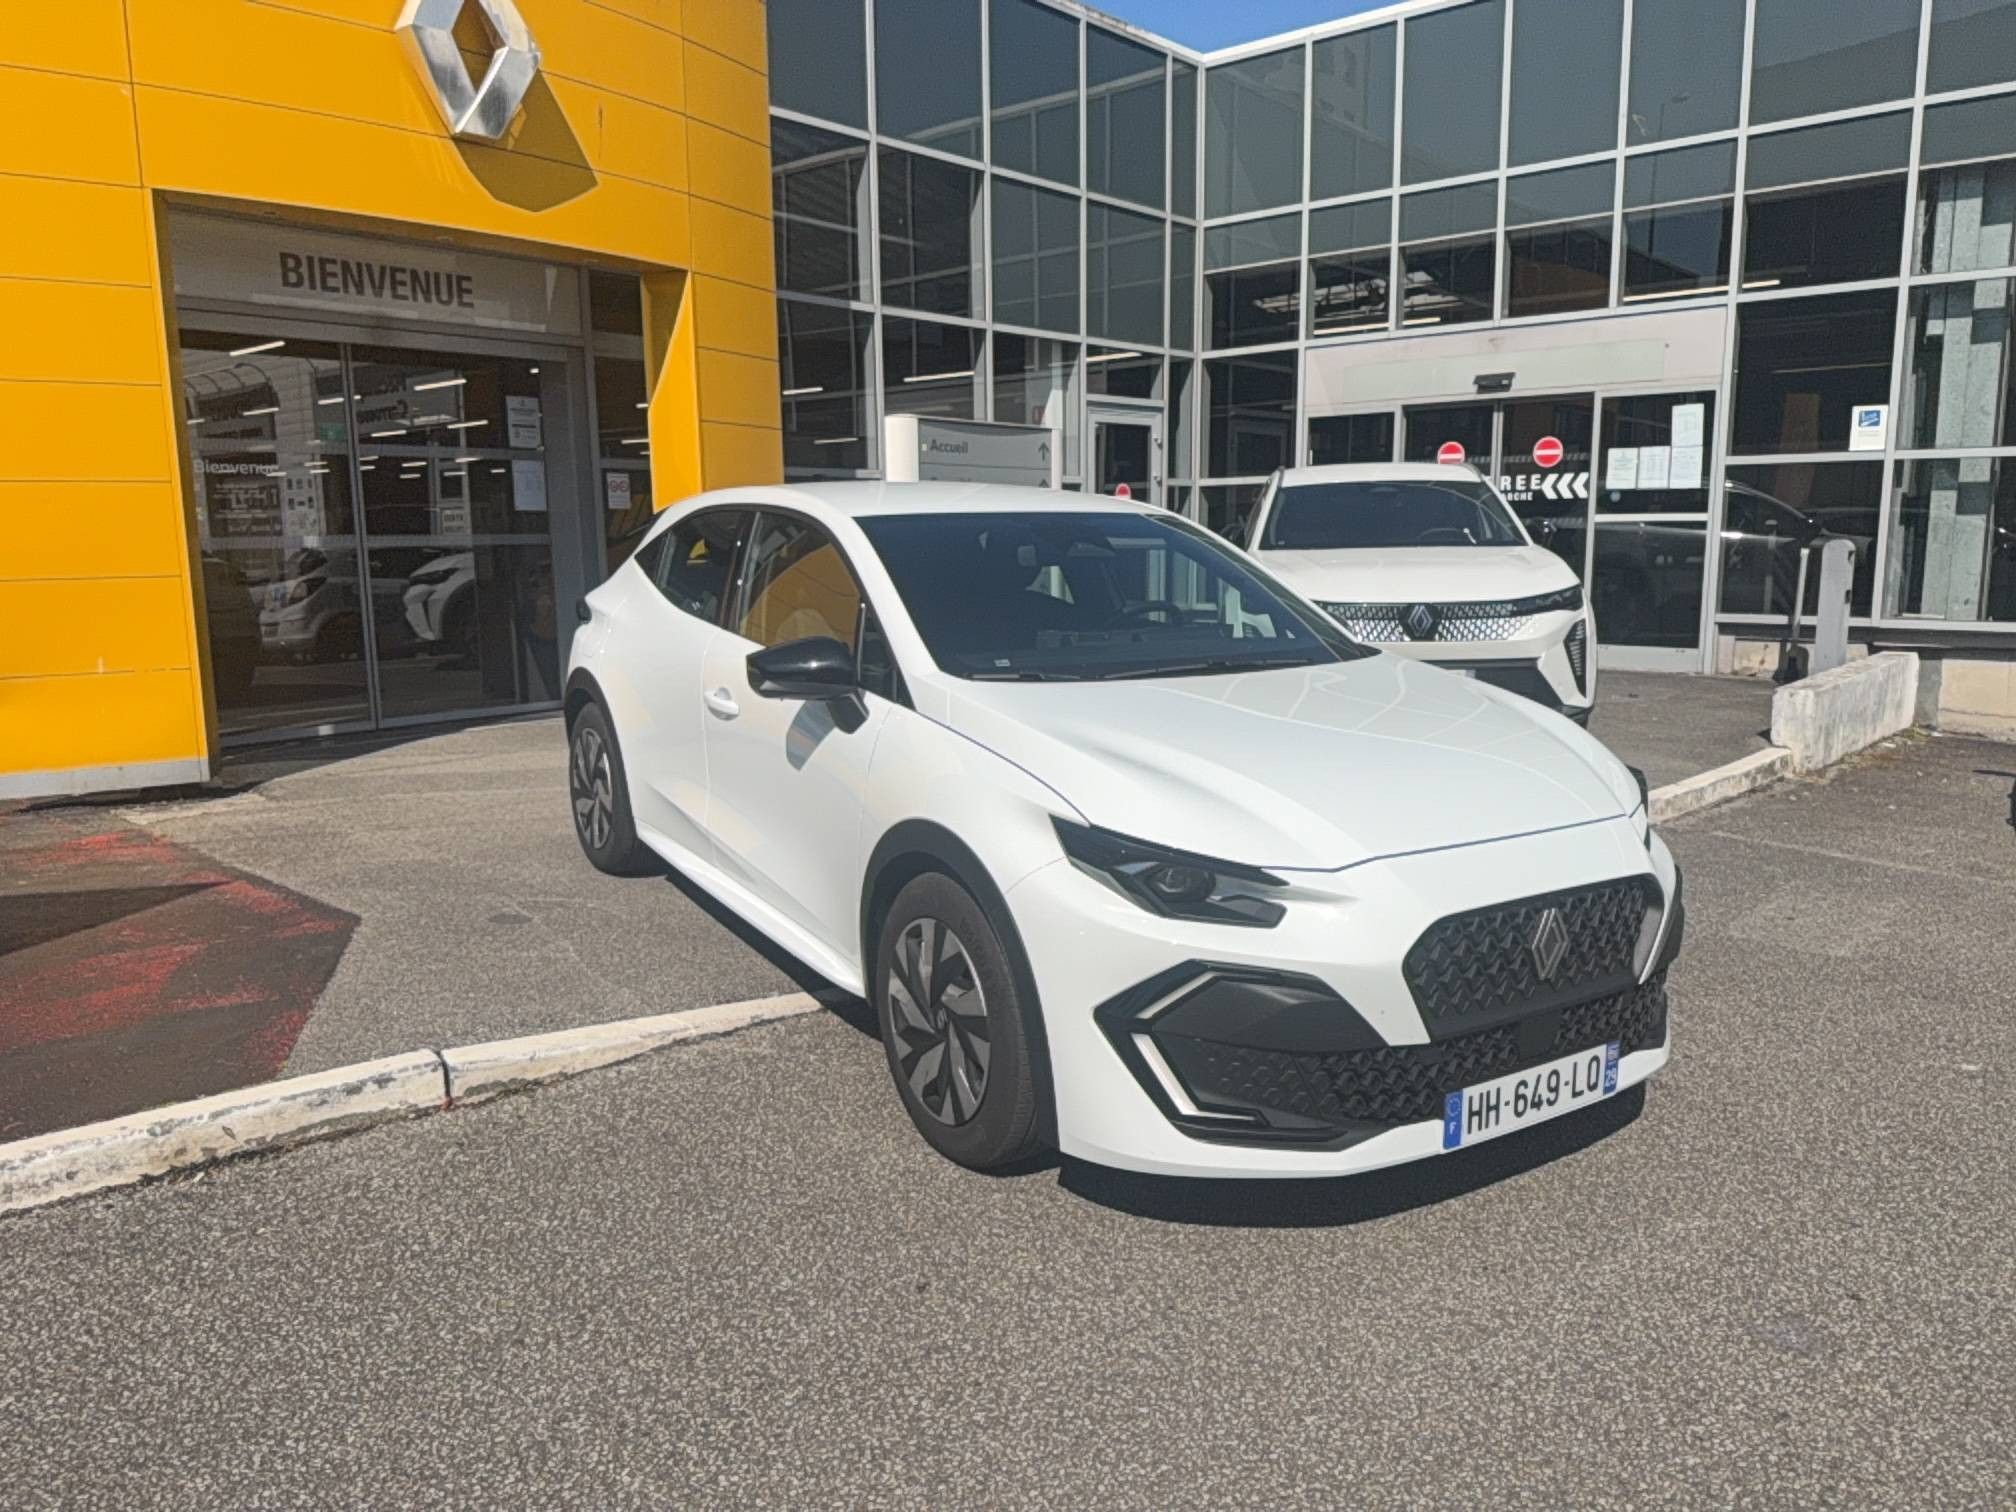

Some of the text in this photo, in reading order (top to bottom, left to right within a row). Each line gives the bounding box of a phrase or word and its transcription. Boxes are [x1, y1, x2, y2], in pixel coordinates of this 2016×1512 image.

[279, 252, 475, 309] BIENVENUE
[930, 438, 969, 455] Accueil
[1449, 1121, 1457, 1135] F
